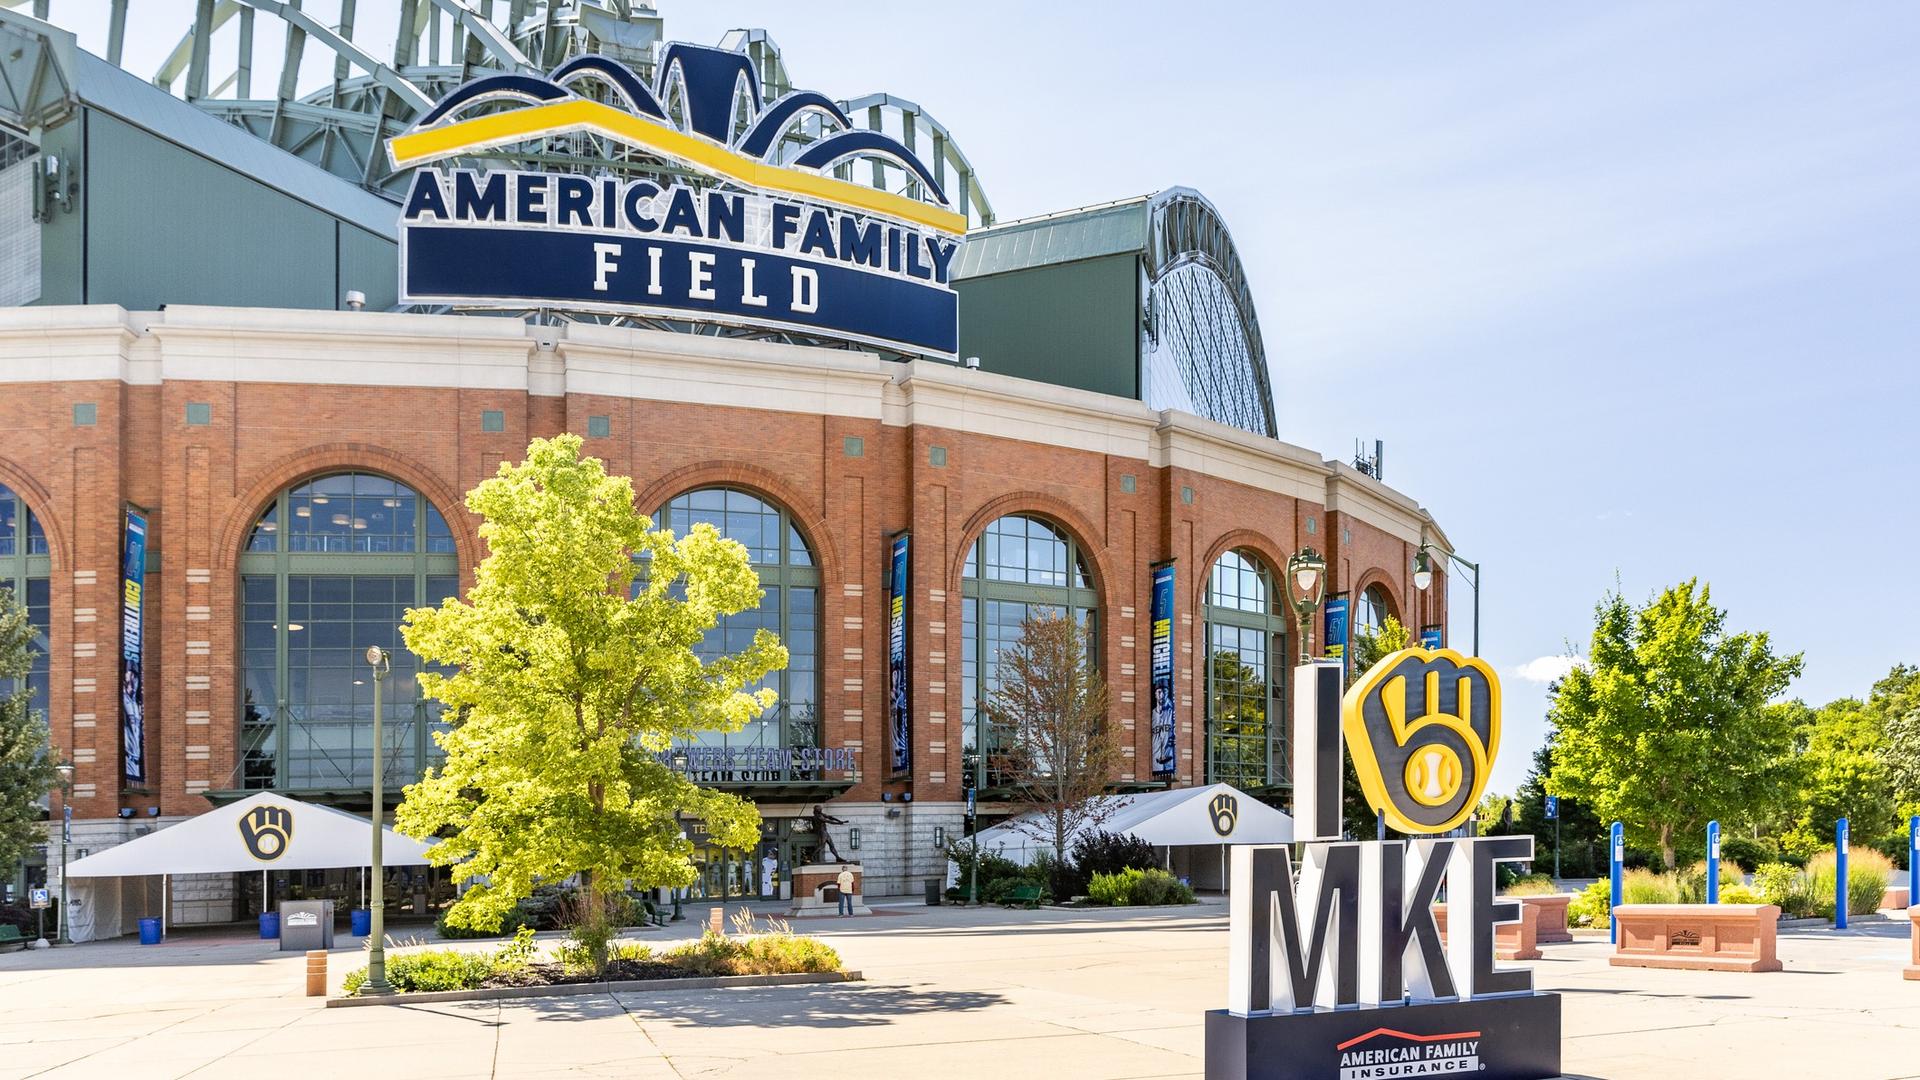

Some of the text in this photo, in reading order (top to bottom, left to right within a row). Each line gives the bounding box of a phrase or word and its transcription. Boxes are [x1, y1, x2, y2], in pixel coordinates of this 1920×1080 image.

[404, 170, 957, 284] AMERICAN FAMILY
[594, 243, 818, 314] FIELD
[124, 579, 141, 662] CONTRERAS
[891, 595, 904, 663] HOSKINS
[1153, 618, 1171, 684] MITCHELL
[744, 748, 792, 771] TEAM
[802, 747, 855, 771] STORE
[1240, 835, 1535, 1016] MKE
[1340, 1041, 1479, 1067] AMERICAN FAMILY
[1352, 1060, 1468, 1080] INSURANCE
